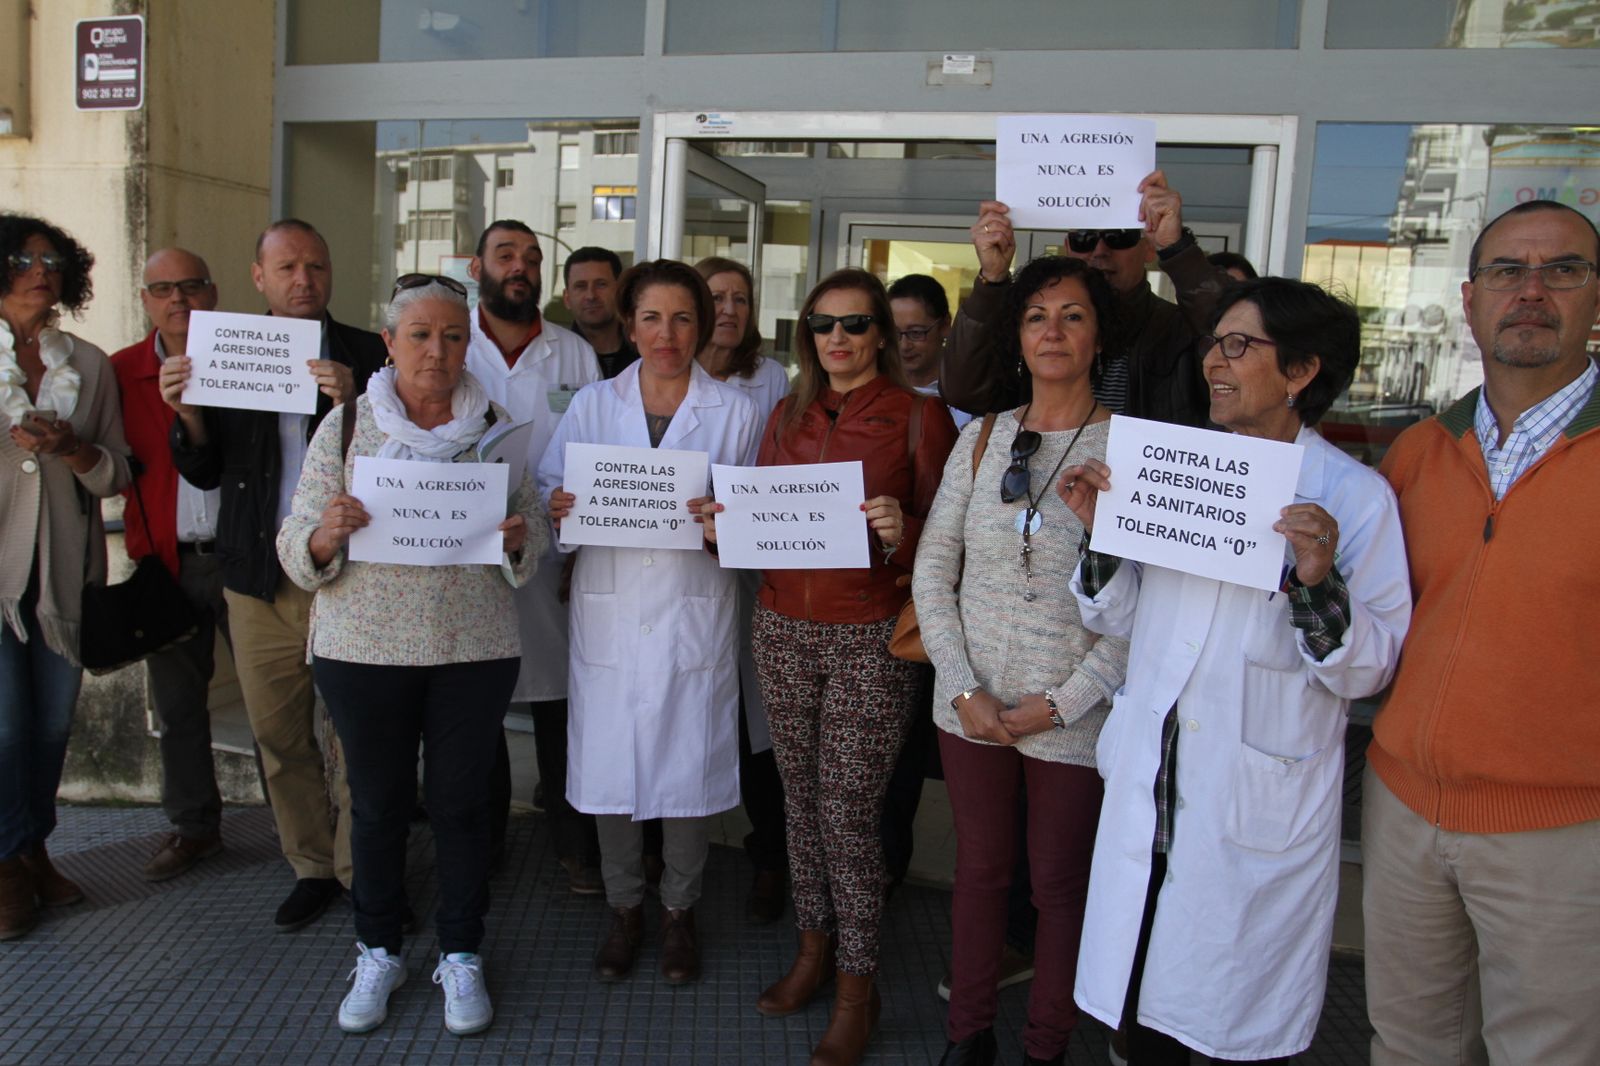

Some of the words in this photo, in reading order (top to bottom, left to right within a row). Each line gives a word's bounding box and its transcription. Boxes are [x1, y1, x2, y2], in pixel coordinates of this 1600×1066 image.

[82, 88, 98, 98] 902
[112, 88, 123, 98] 22
[125, 87, 136, 97] 22
[1021, 133, 1050, 144] UNA
[1060, 131, 1134, 145] AGRESIÓN
[1037, 164, 1087, 176] NUNCA
[1097, 164, 1115, 176] ES
[1037, 193, 1111, 208] SOLUCIÓN
[214, 328, 264, 341] CONTRA
[266, 332, 291, 343] LAS
[213, 343, 290, 359] AGRESIONES
[209, 359, 218, 369] A
[221, 360, 292, 376] SANITARIOS
[199, 377, 275, 394] TOLERANCIA
[1142, 444, 1211, 470] CONTRA
[1215, 457, 1250, 476] LAS
[594, 461, 648, 475] CONTRA
[650, 465, 677, 477] LAS
[376, 476, 405, 489] UNA
[414, 478, 487, 492] AGRESIÓN
[592, 477, 676, 493] AGRESIONES
[731, 484, 760, 495] UNA
[768, 479, 841, 494] AGRESIÓN
[1137, 466, 1248, 500] AGRESIONES
[588, 495, 599, 506] A
[601, 496, 678, 511] SANITARIOS
[1130, 490, 1142, 505] A
[1146, 493, 1247, 526] SANITARIOS
[392, 507, 441, 520] NUNCA
[451, 510, 468, 520] ES
[751, 511, 800, 523] NUNCA
[808, 511, 826, 522] ES
[578, 515, 659, 530] TOLERANCIA
[1115, 515, 1218, 551] TOLERANCIA
[392, 535, 464, 549] SOLUCIÓN
[756, 537, 827, 551] SOLUCIÓN
